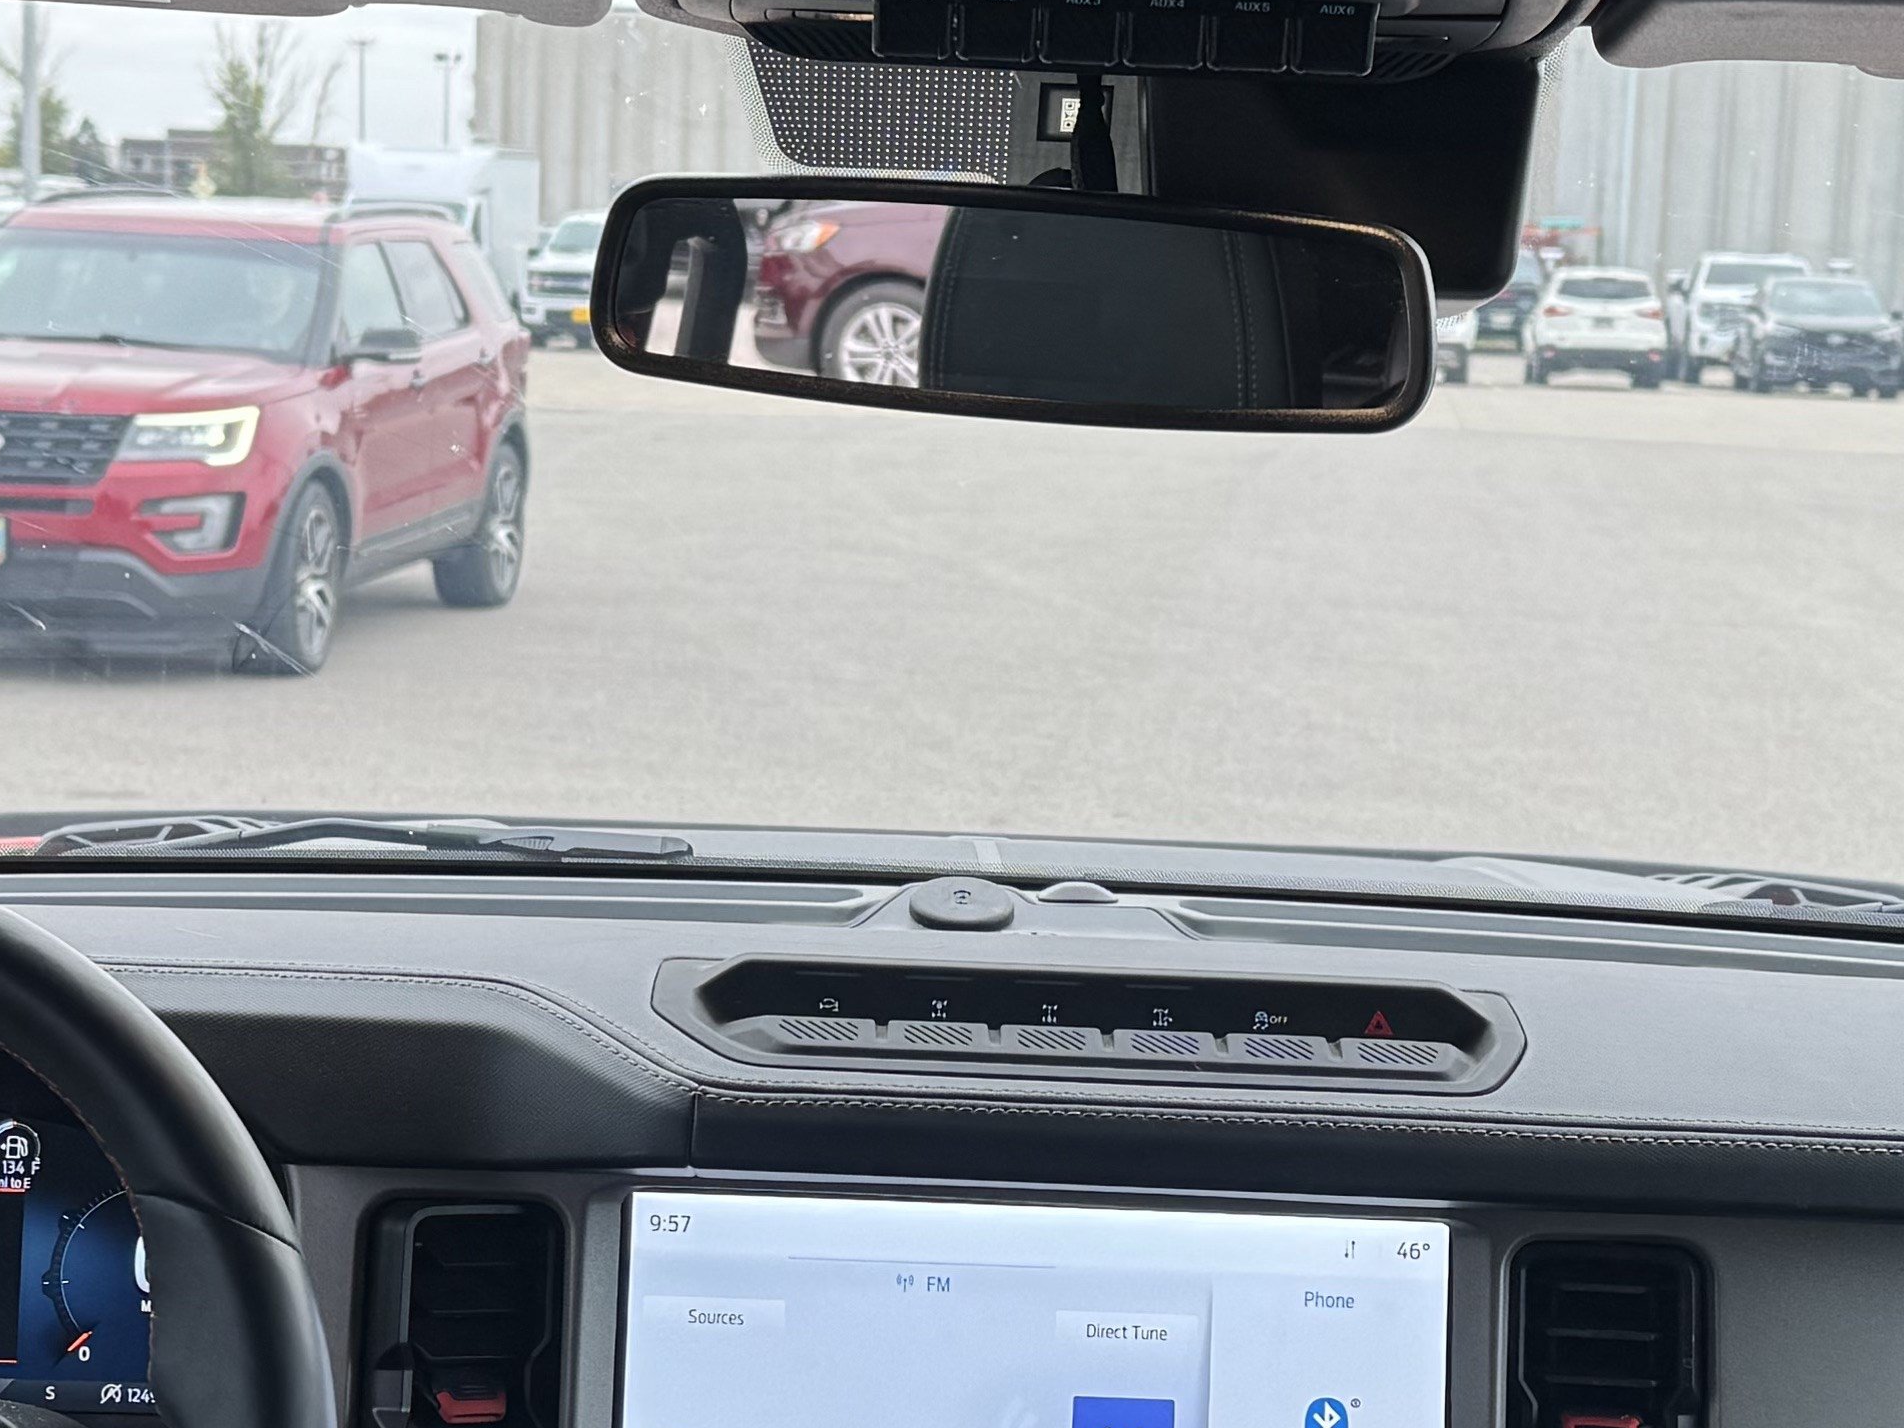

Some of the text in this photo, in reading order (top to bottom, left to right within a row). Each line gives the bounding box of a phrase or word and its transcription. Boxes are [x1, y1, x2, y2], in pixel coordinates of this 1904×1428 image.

[2, 1160, 25, 1175] 134
[10, 1177, 22, 1189] to
[23, 1177, 32, 1190] E
[648, 1213, 692, 1234] 9:57
[926, 1276, 952, 1294] FM
[1303, 1289, 1356, 1311] Phone
[687, 1308, 745, 1327] Sources
[1085, 1322, 1169, 1344] Direct Tune
[77, 1344, 91, 1363] 0
[45, 1383, 56, 1401] S
